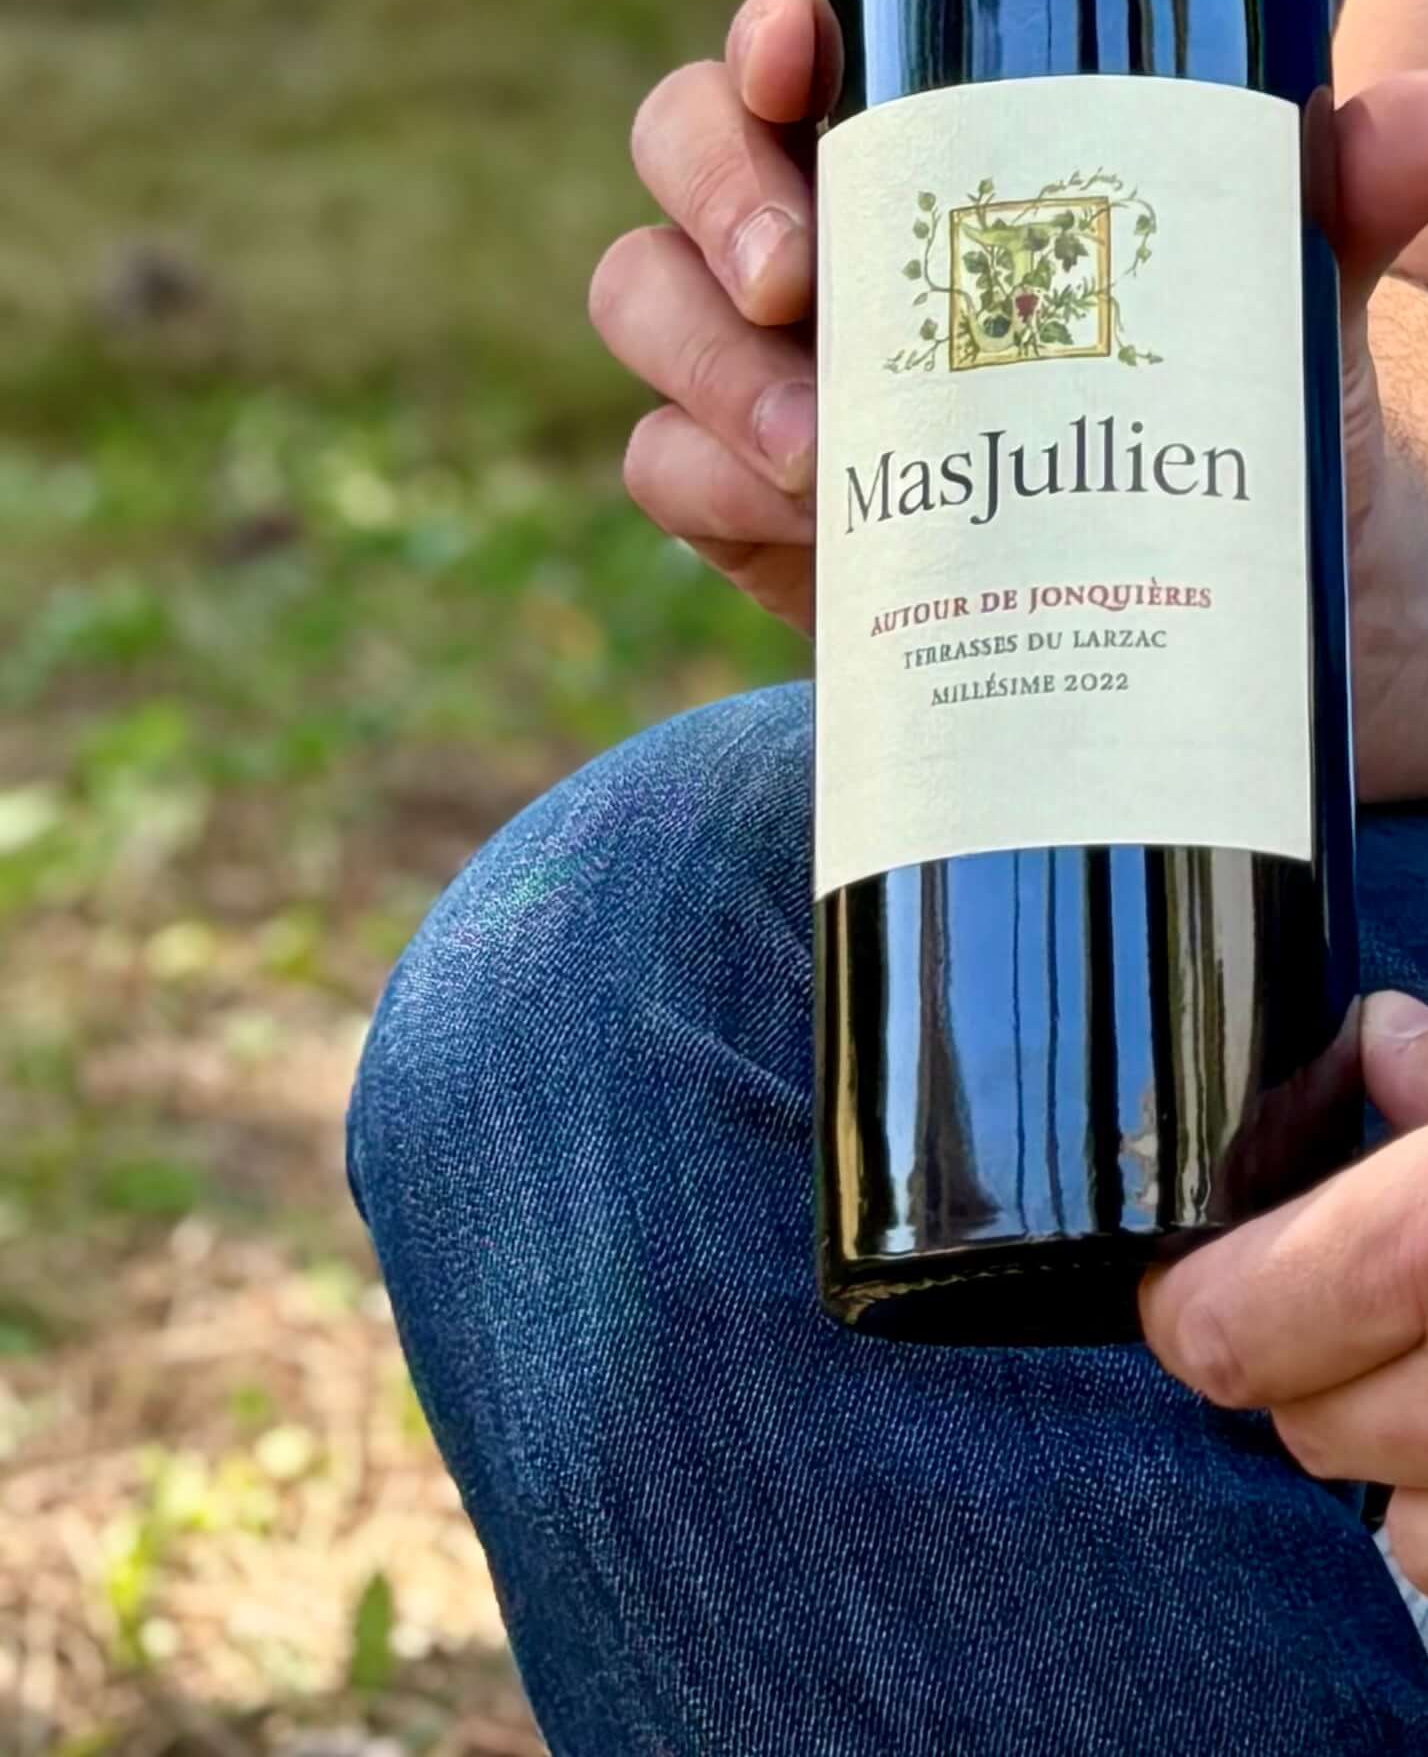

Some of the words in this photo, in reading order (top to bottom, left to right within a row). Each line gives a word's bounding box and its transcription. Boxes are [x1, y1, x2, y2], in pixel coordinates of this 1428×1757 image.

[845, 415, 1251, 534] MasJullien
[870, 596, 970, 637] AUTOUR
[980, 589, 1018, 613] DE
[1028, 577, 1213, 613] JONQUIÈRES
[903, 634, 1018, 669] TERRASSES
[1027, 632, 1063, 651] DU
[1073, 630, 1167, 649] LARZAC
[931, 672, 1056, 706] MILLÉSIME
[1064, 673, 1129, 692] 2022
